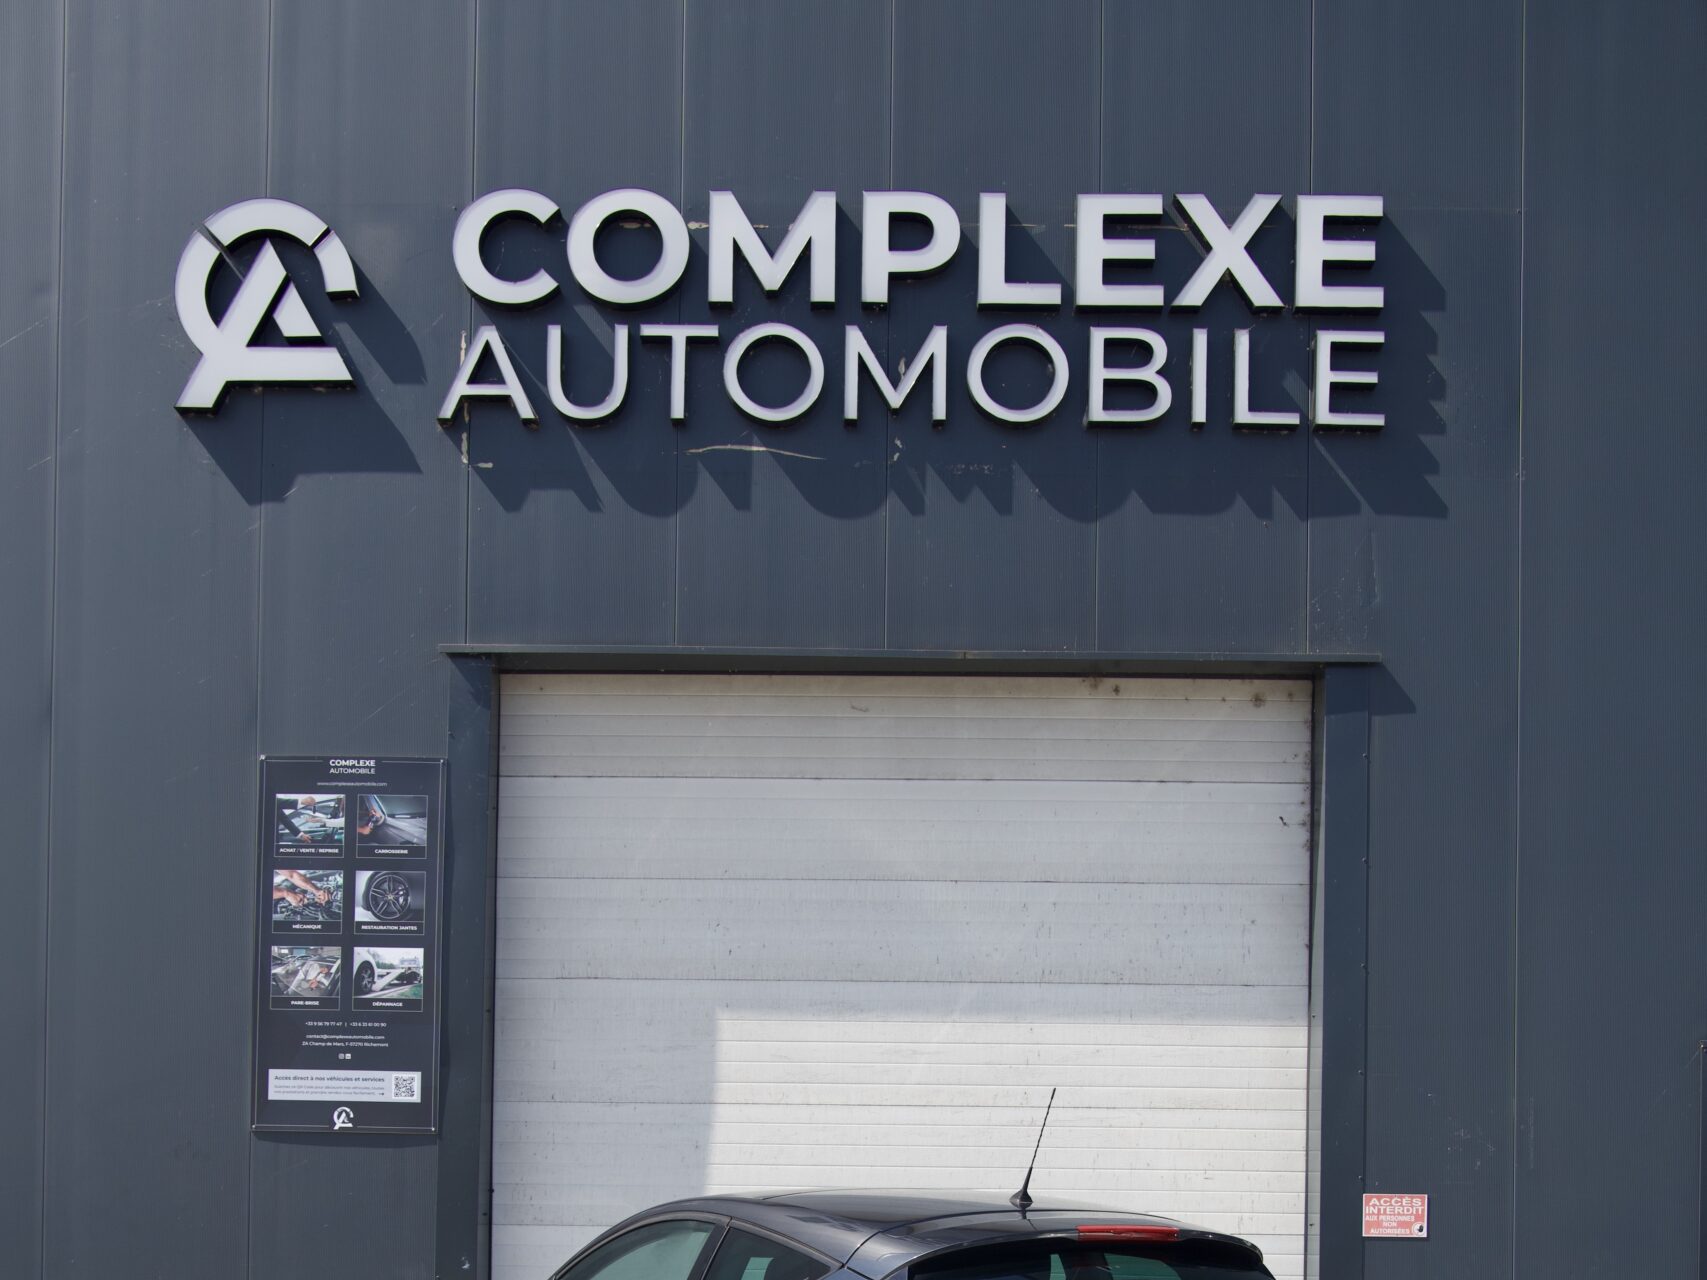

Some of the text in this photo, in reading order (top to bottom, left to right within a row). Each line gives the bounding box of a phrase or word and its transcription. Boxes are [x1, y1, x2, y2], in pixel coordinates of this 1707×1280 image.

[453, 189, 1385, 310] COMPLEXE
[438, 323, 1386, 430] AUTOMOBILE
[1365, 1206, 1424, 1215] INTERDIT
[1369, 1196, 1422, 1206] ACCÈS
